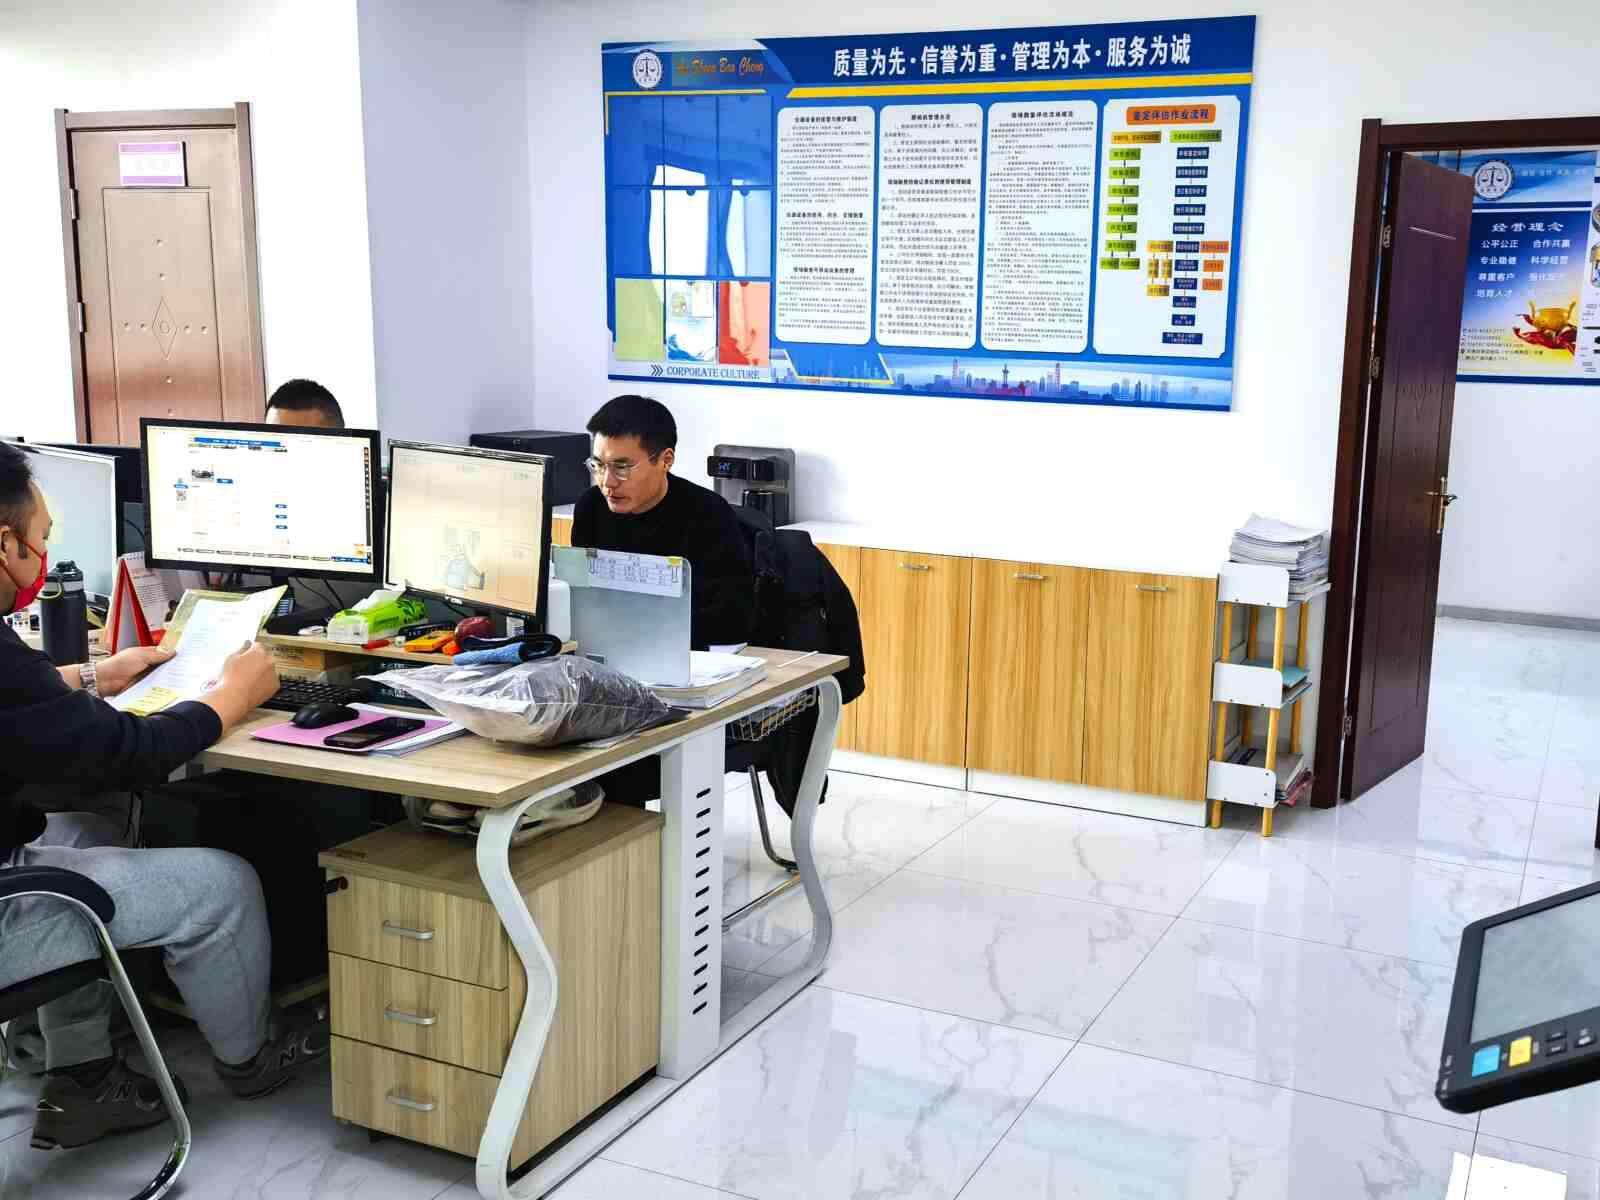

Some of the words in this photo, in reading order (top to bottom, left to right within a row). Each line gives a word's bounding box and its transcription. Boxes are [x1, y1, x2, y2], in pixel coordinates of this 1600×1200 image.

[833, 33, 1192, 77] 质量为先·信誉为重·管理为本·服务为诚
[1490, 222, 1565, 233] 经营理念
[1480, 239, 1519, 249] 公平公正
[1532, 239, 1570, 249] 合作共赢
[666, 365, 719, 378] CORPORATE
[720, 368, 761, 380] CULTURE
